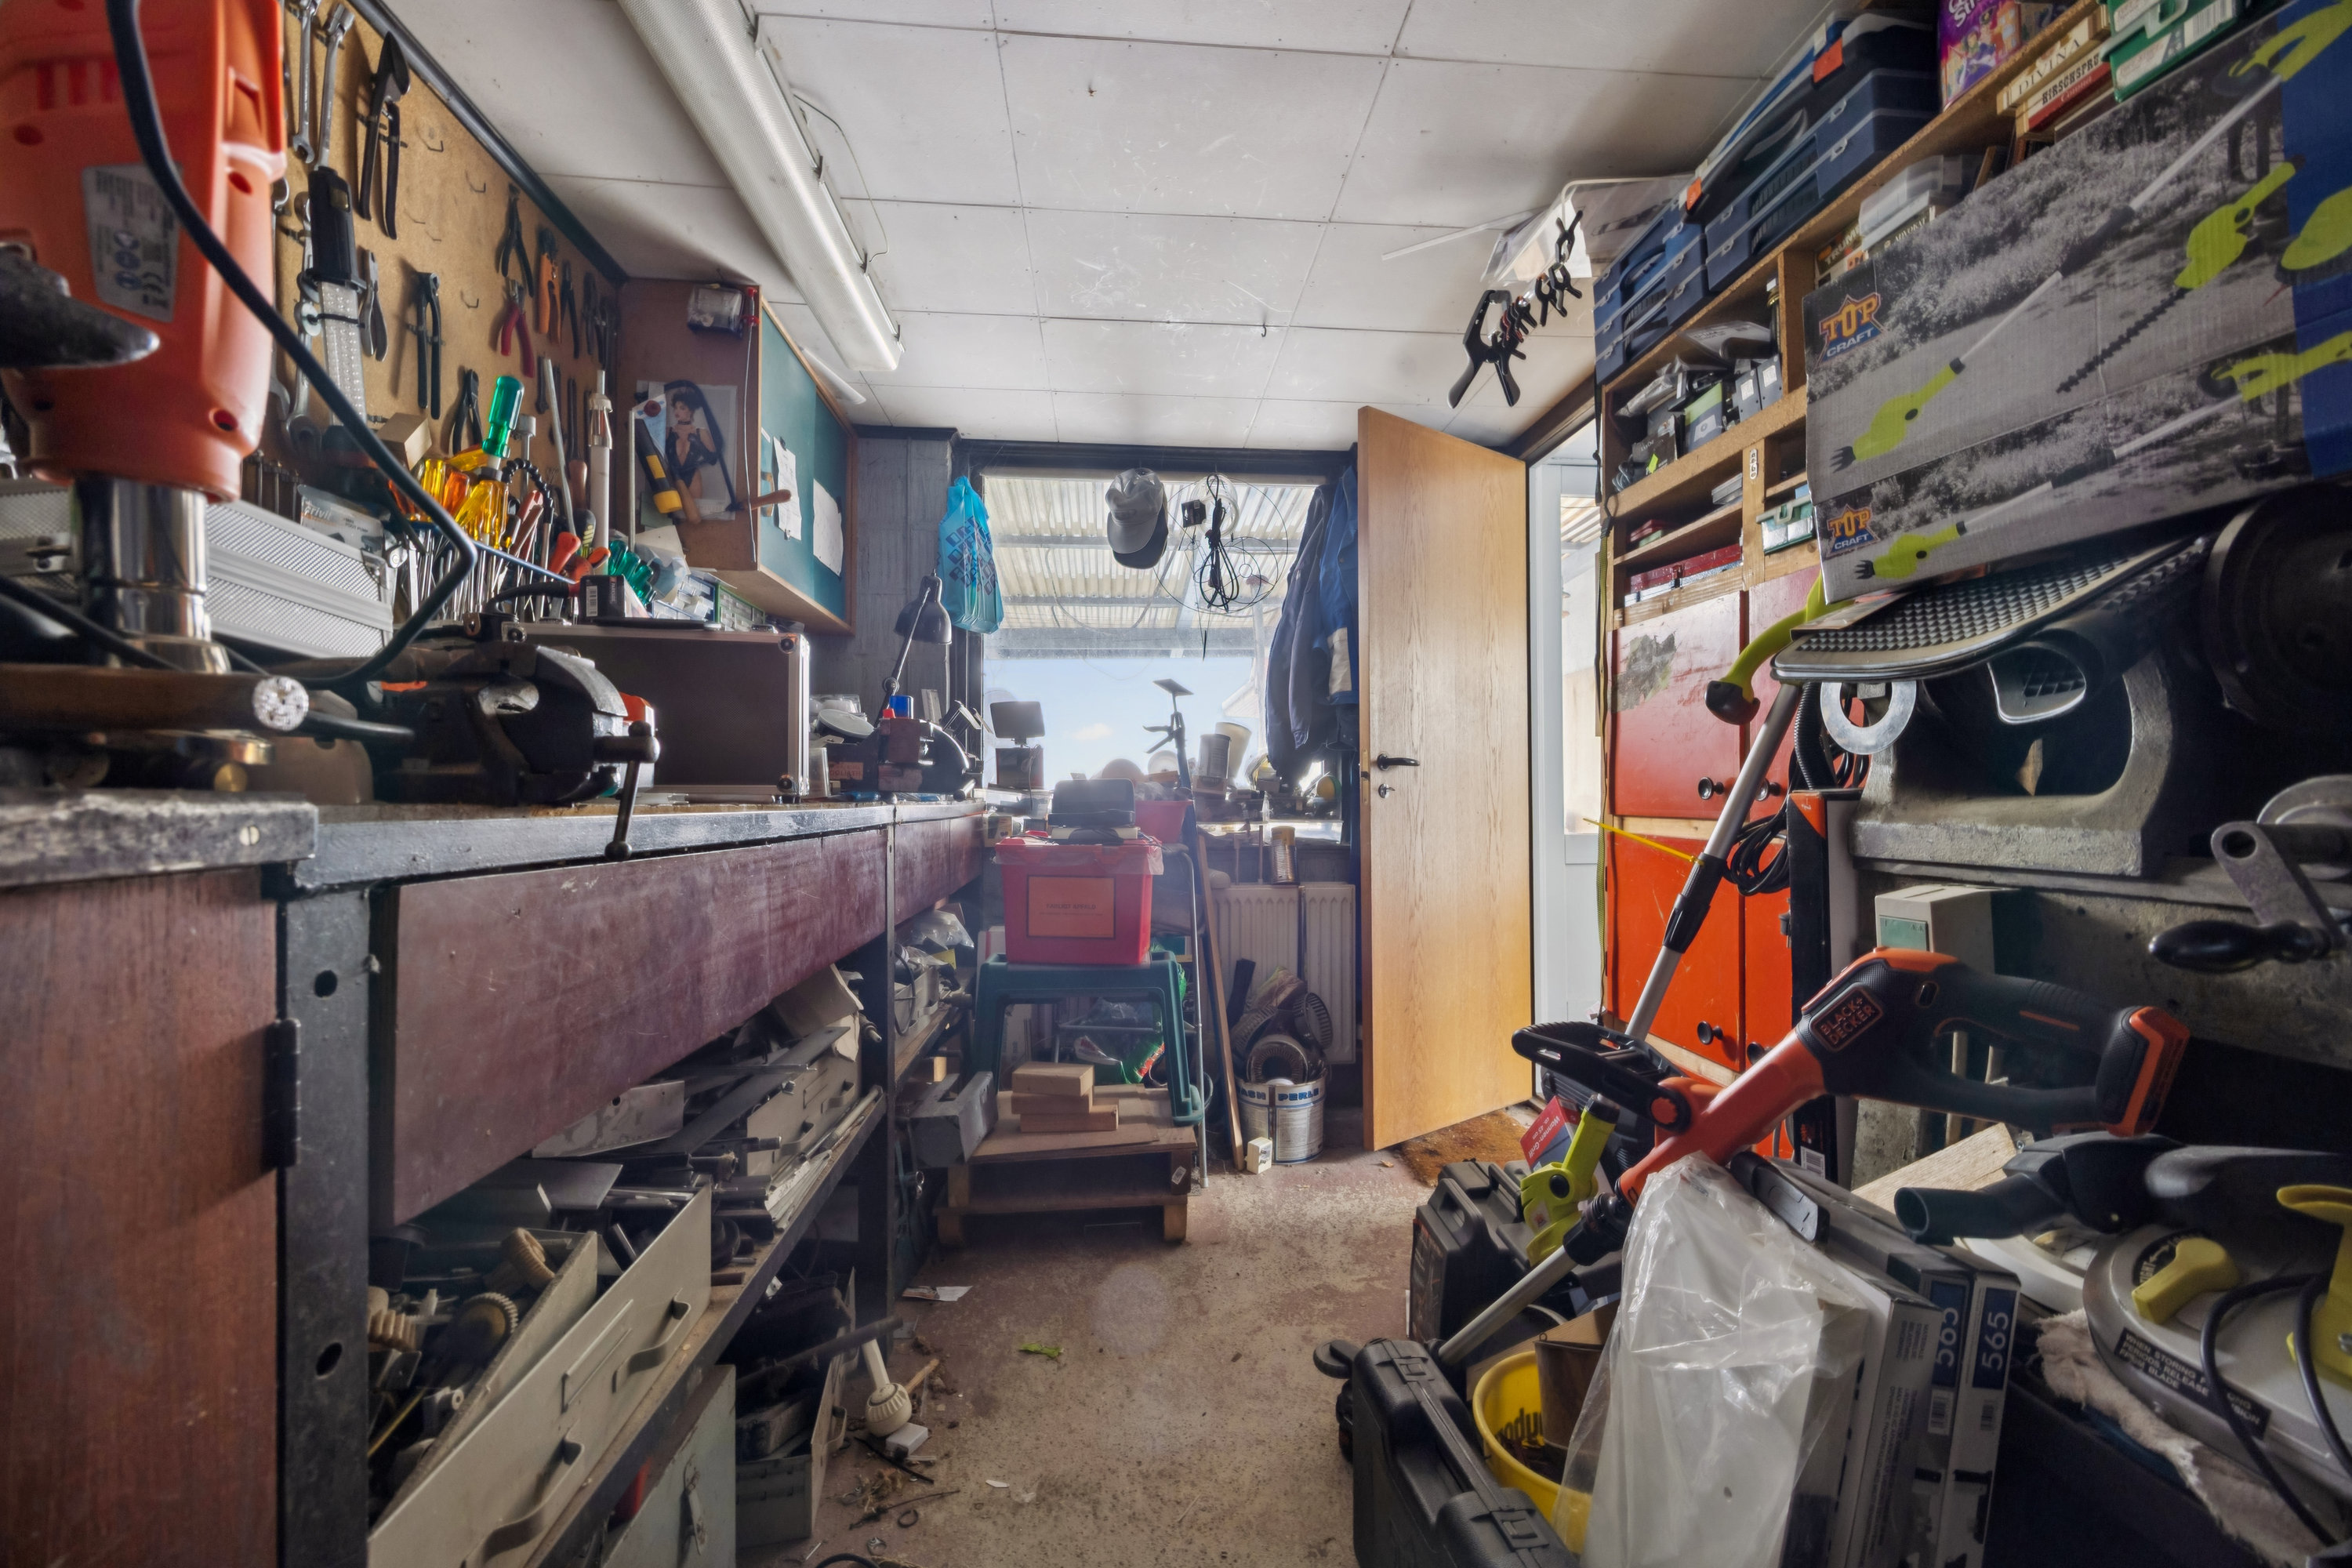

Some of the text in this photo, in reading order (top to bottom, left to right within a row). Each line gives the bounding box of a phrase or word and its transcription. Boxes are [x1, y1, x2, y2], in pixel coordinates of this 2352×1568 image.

[2018, 38, 2081, 95] DIVINA
[2042, 53, 2100, 105] HIRSCHSPRU
[1822, 296, 1878, 341] TOP
[1827, 326, 1875, 358] CRAFT
[1829, 509, 1870, 538] TOP
[1835, 533, 1870, 550] CRAFT
[1829, 1006, 1876, 1046] DECKER
[1529, 1116, 1560, 1159] Wannen-Griff
[1980, 1311, 2009, 1371] 565
[2125, 1333, 2152, 1354] WHEN
[2154, 1352, 2197, 1380] STORING
[2148, 1367, 2180, 1390] BLADE
[2163, 1367, 2210, 1397] RELEASE
